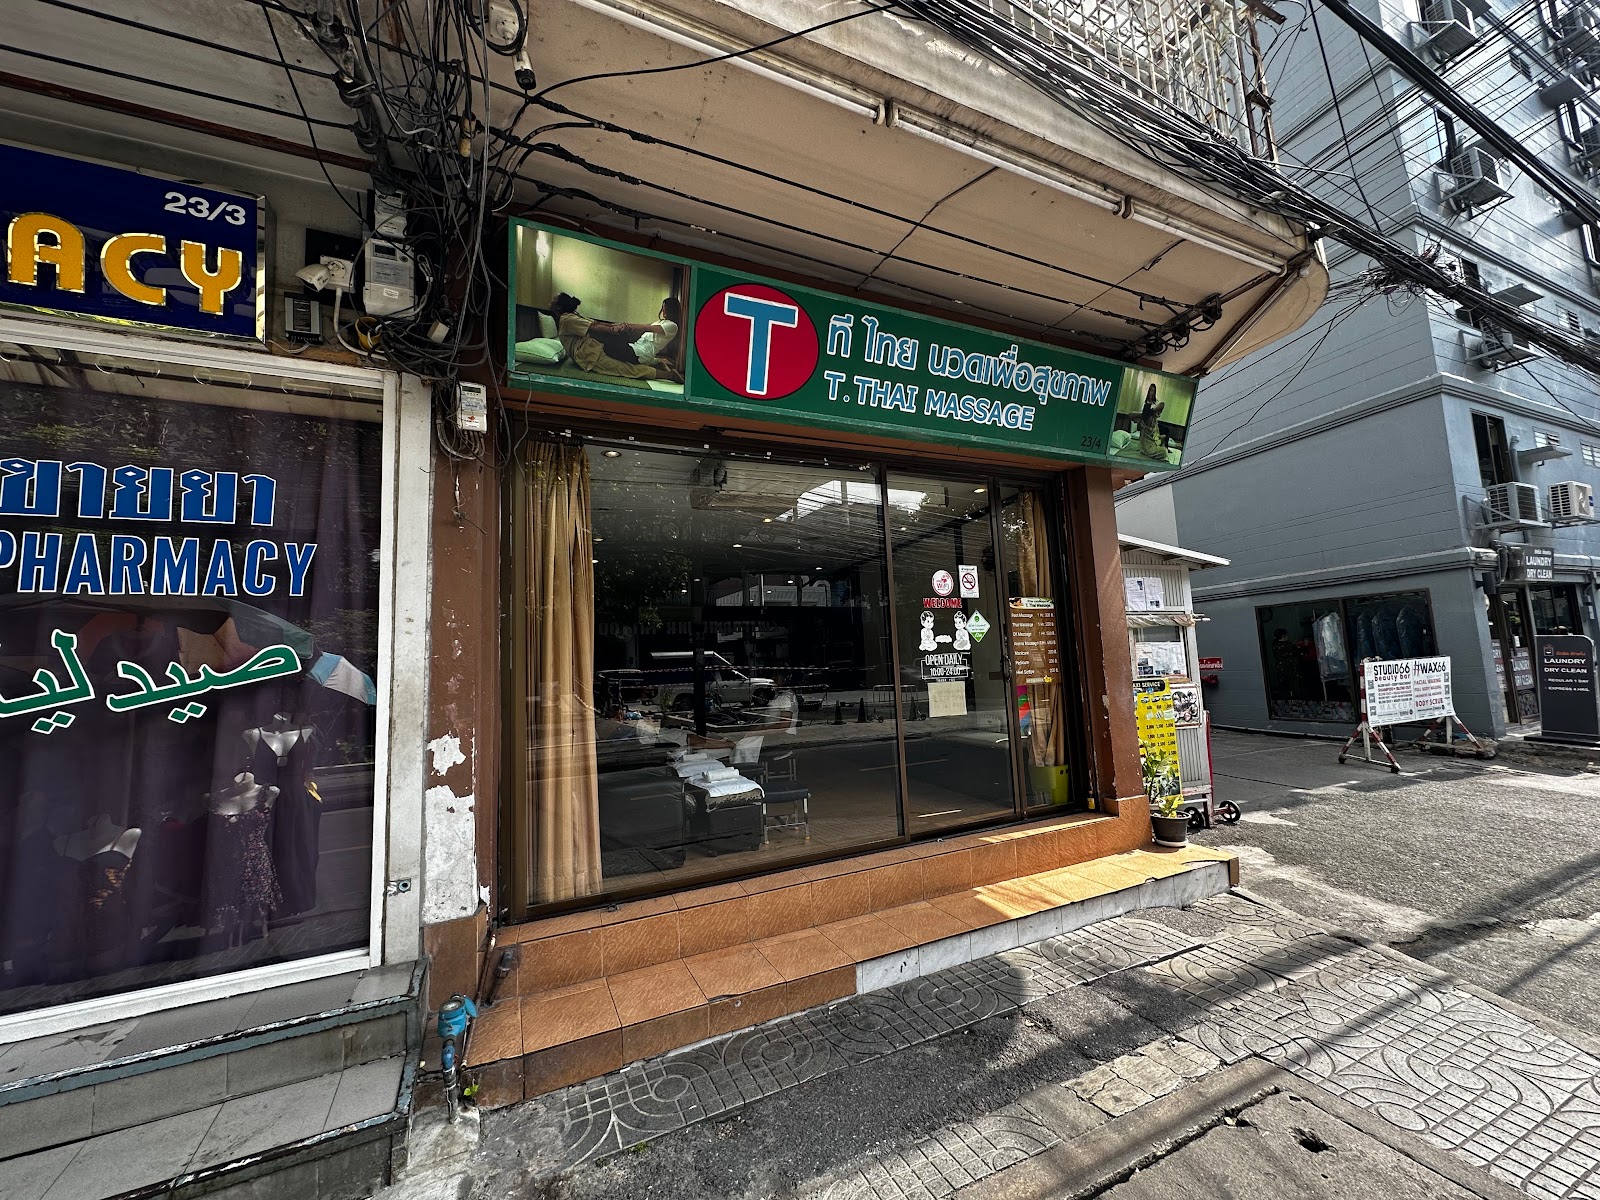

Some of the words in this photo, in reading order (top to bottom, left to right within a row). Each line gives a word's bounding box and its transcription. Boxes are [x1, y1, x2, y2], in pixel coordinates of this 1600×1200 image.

[164, 191, 246, 226] 23/3
[8, 212, 242, 315] ACY
[724, 292, 798, 395] T
[827, 314, 853, 358] ที
[861, 315, 919, 370] ไทย
[928, 344, 1111, 406] นวดเพื่อสุขภาพ
[854, 375, 918, 413] THAI
[924, 388, 1035, 431] MASSAGE
[1081, 436, 1102, 450] 23/4
[1526, 556, 1552, 566] LAUNDRY
[1526, 569, 1537, 578] DRY
[1537, 569, 1553, 579] CLEAN
[922, 597, 962, 609] WELCOME
[925, 654, 944, 666] OPEN
[944, 654, 963, 665] DAILY
[1374, 674, 1398, 682] beauty
